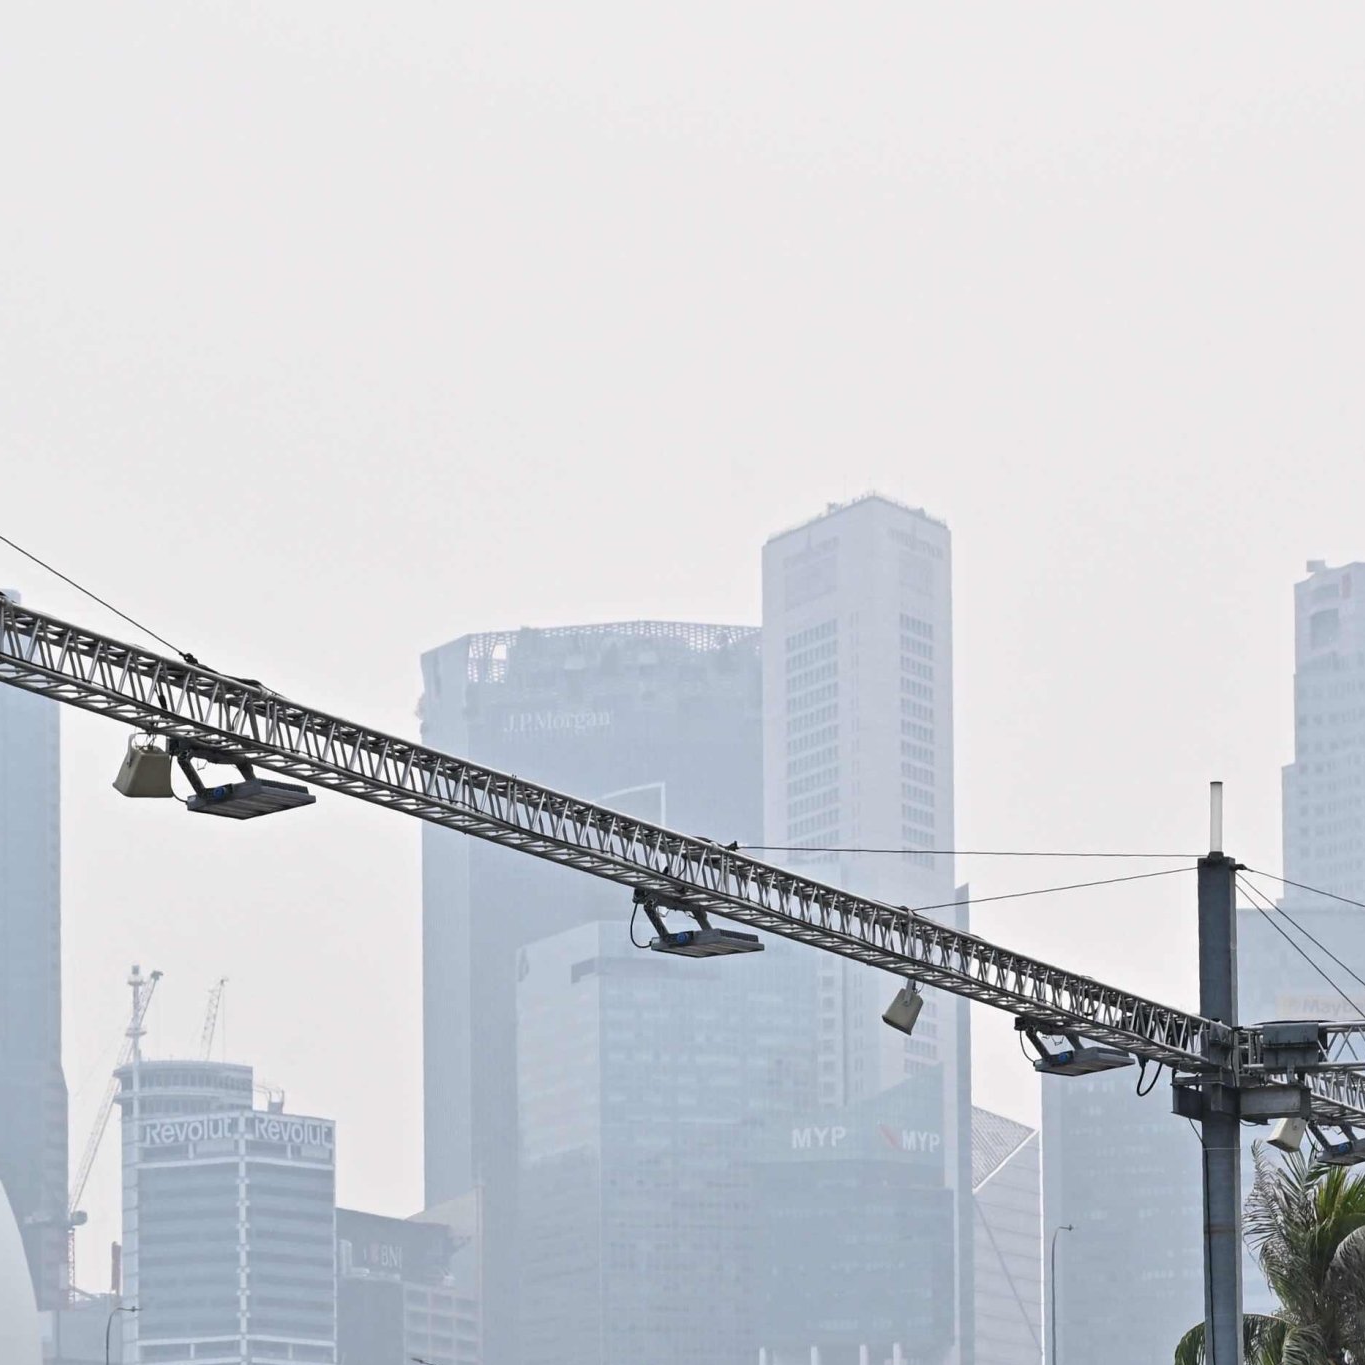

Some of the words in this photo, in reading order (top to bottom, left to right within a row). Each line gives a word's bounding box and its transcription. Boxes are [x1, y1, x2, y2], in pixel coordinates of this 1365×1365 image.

[146, 1117, 233, 1144] Revolut
[254, 1117, 333, 1145] Revolut
[792, 1127, 846, 1148] MYP
[902, 1130, 940, 1152] MYP
